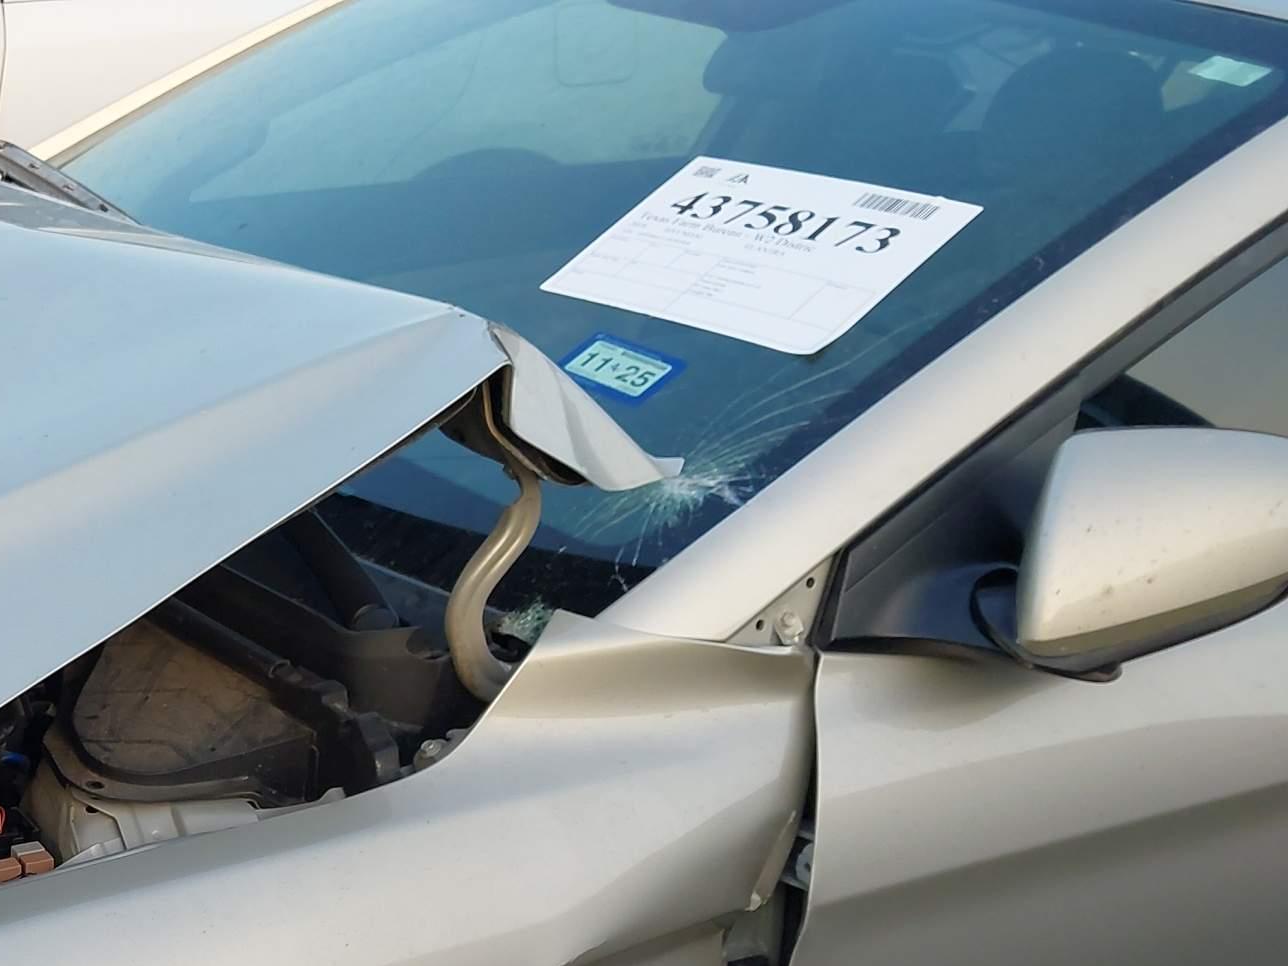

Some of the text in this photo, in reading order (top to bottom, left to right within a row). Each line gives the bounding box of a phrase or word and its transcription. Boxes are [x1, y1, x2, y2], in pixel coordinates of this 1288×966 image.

[670, 191, 902, 254] 43758173
[580, 352, 613, 372] 11
[615, 365, 656, 387] 25
